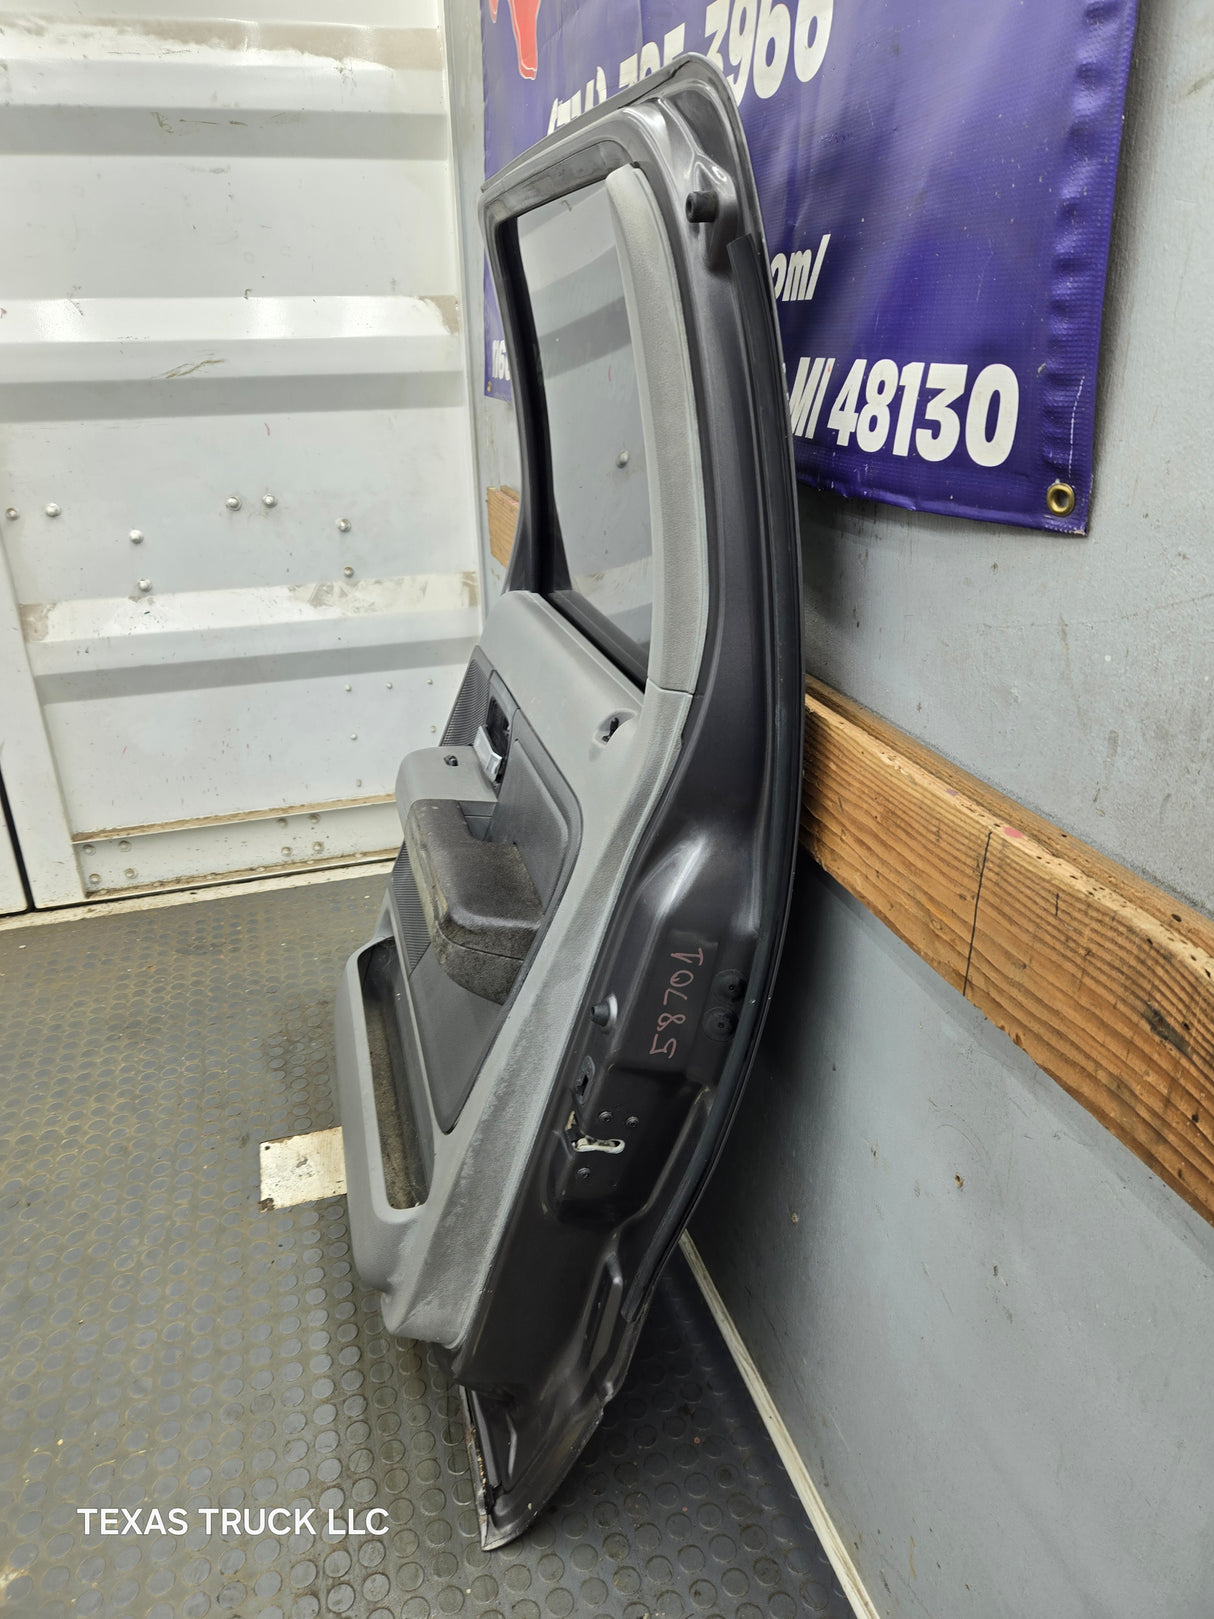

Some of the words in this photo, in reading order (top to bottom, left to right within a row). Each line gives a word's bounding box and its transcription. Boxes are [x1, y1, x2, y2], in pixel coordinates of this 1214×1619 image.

[789, 357, 836, 439] MI
[827, 358, 1020, 468] 48130
[649, 947, 704, 1059] 58701
